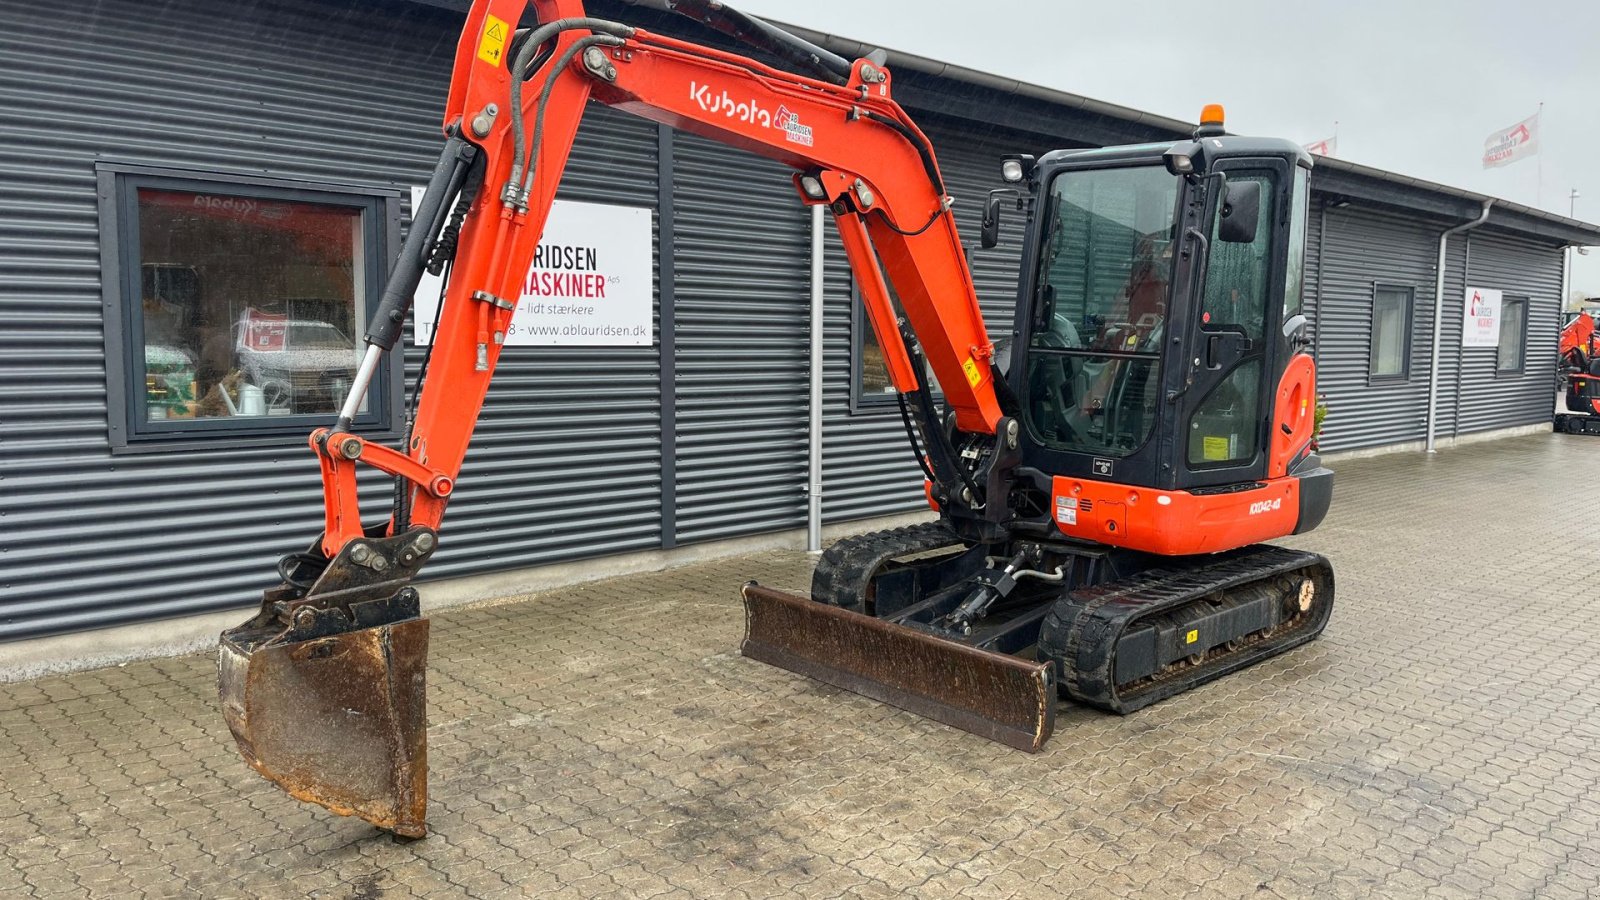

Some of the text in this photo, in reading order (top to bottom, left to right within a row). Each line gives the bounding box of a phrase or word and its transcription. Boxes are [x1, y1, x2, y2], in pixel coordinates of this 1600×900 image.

[690, 81, 771, 128] Kubota
[533, 245, 597, 271] RIDSEN
[527, 302, 545, 315] lidt
[547, 304, 594, 315] stærkere
[527, 324, 647, 337] www.ablauridsen.dk
